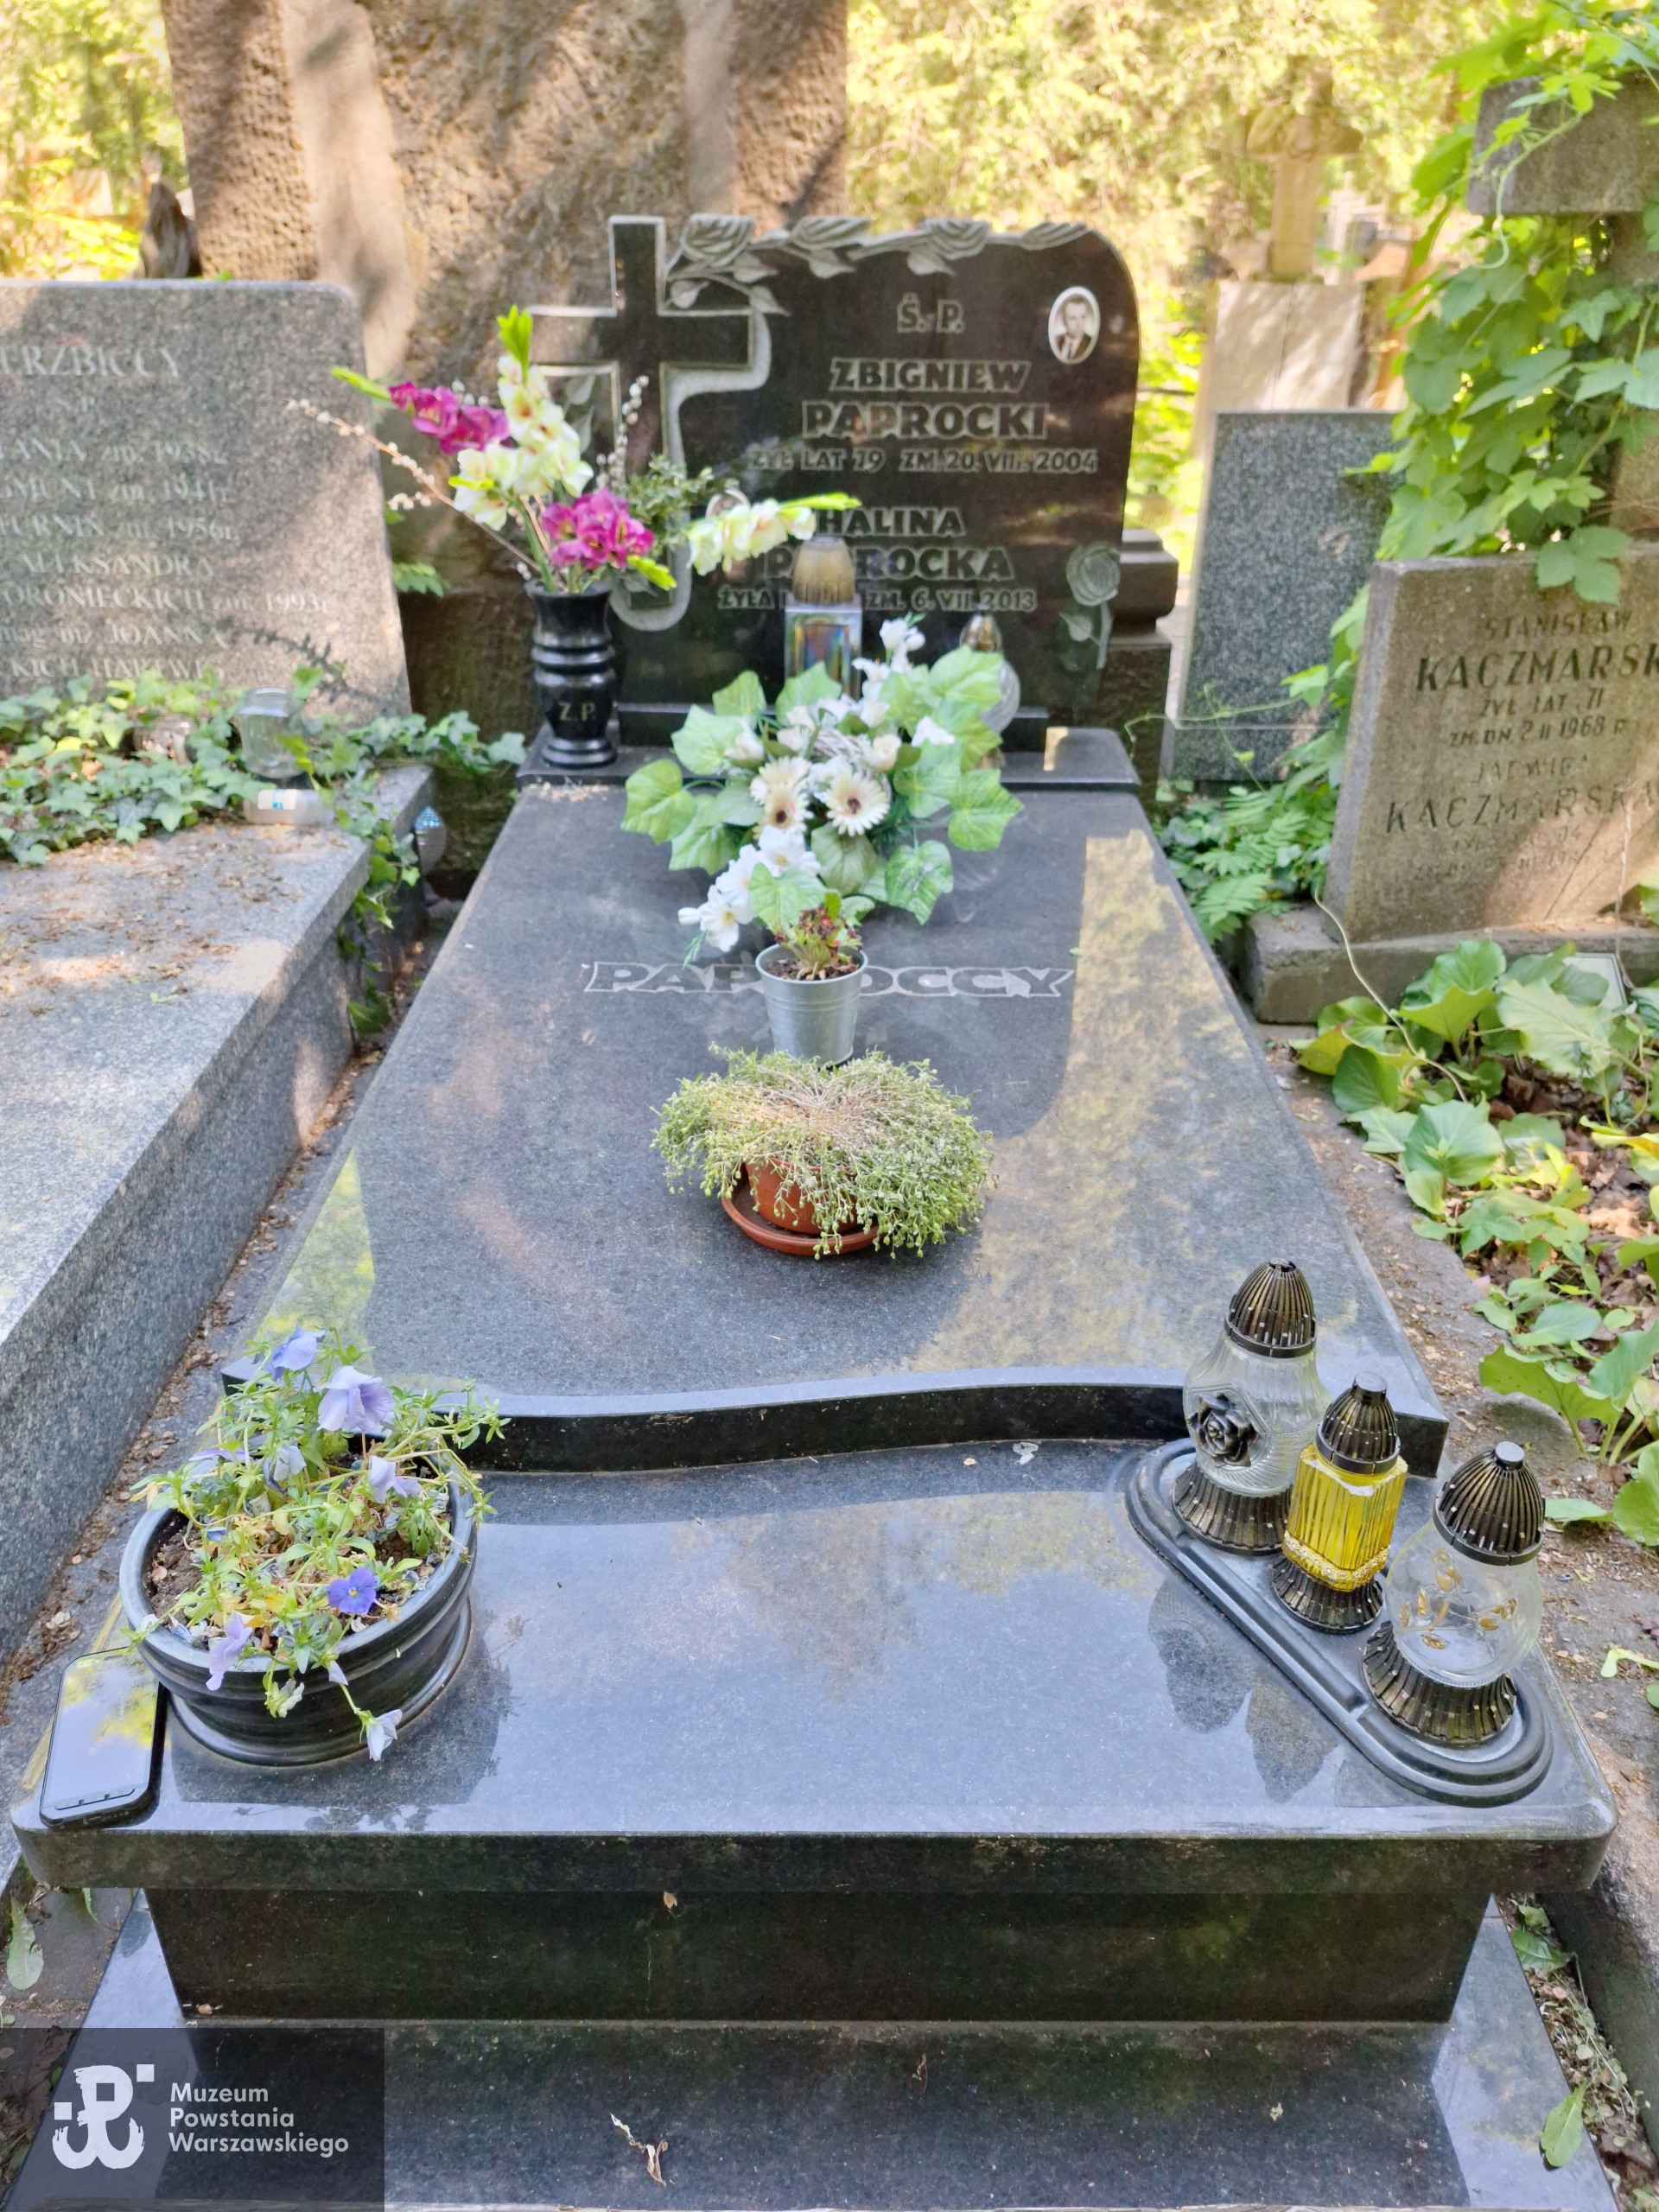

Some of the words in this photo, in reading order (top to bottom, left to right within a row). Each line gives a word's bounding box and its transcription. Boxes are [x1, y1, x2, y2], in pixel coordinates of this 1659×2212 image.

[829, 357, 1032, 393] ZBIGNIEW
[802, 401, 1049, 439] PAPROCKI
[800, 448, 847, 472] LAT
[852, 447, 887, 474] 79
[1033, 448, 1098, 474] 2004
[815, 506, 967, 537] HALINA
[764, 544, 1015, 582] PROCKA
[978, 588, 1038, 613] 2013
[585, 961, 1075, 998] PAPOCCY
